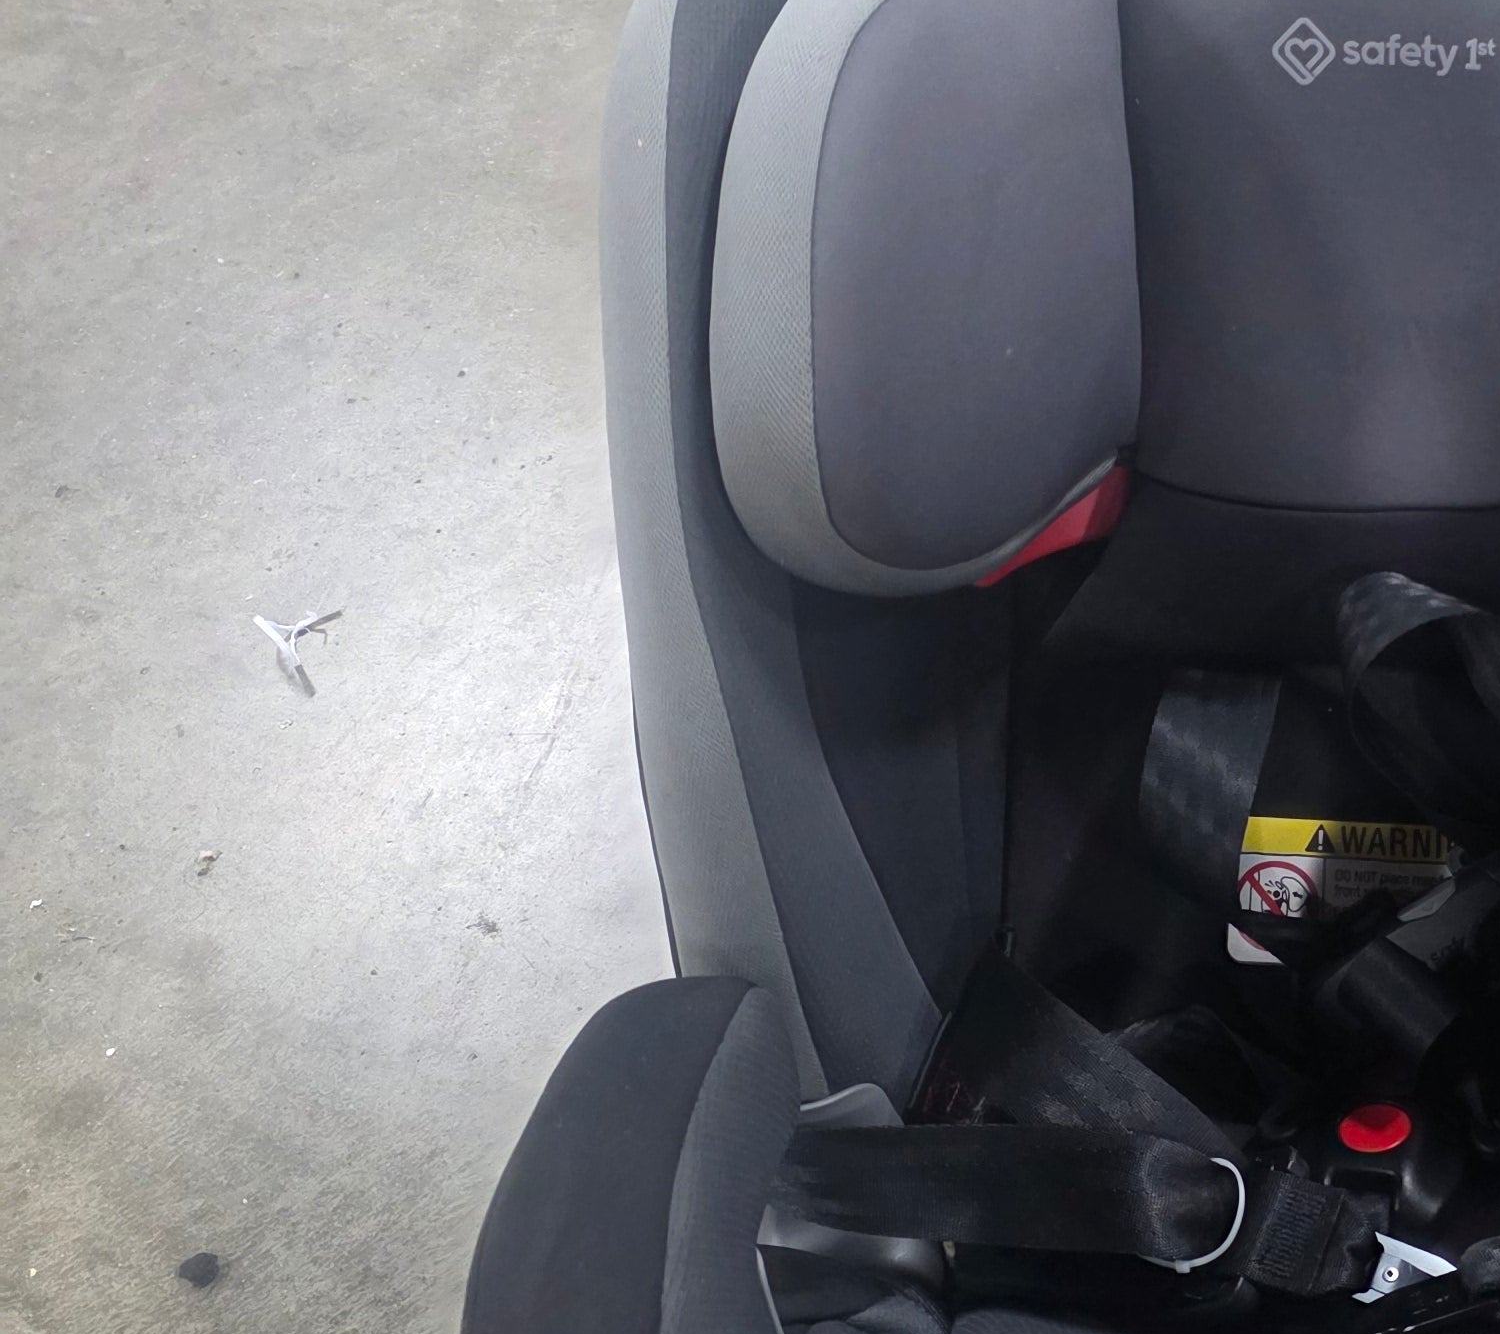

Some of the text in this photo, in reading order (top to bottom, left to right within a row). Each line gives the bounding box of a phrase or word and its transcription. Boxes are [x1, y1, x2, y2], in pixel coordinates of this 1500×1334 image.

[1343, 34, 1496, 76] safety 1st
[1341, 826, 1442, 859] WARNI
